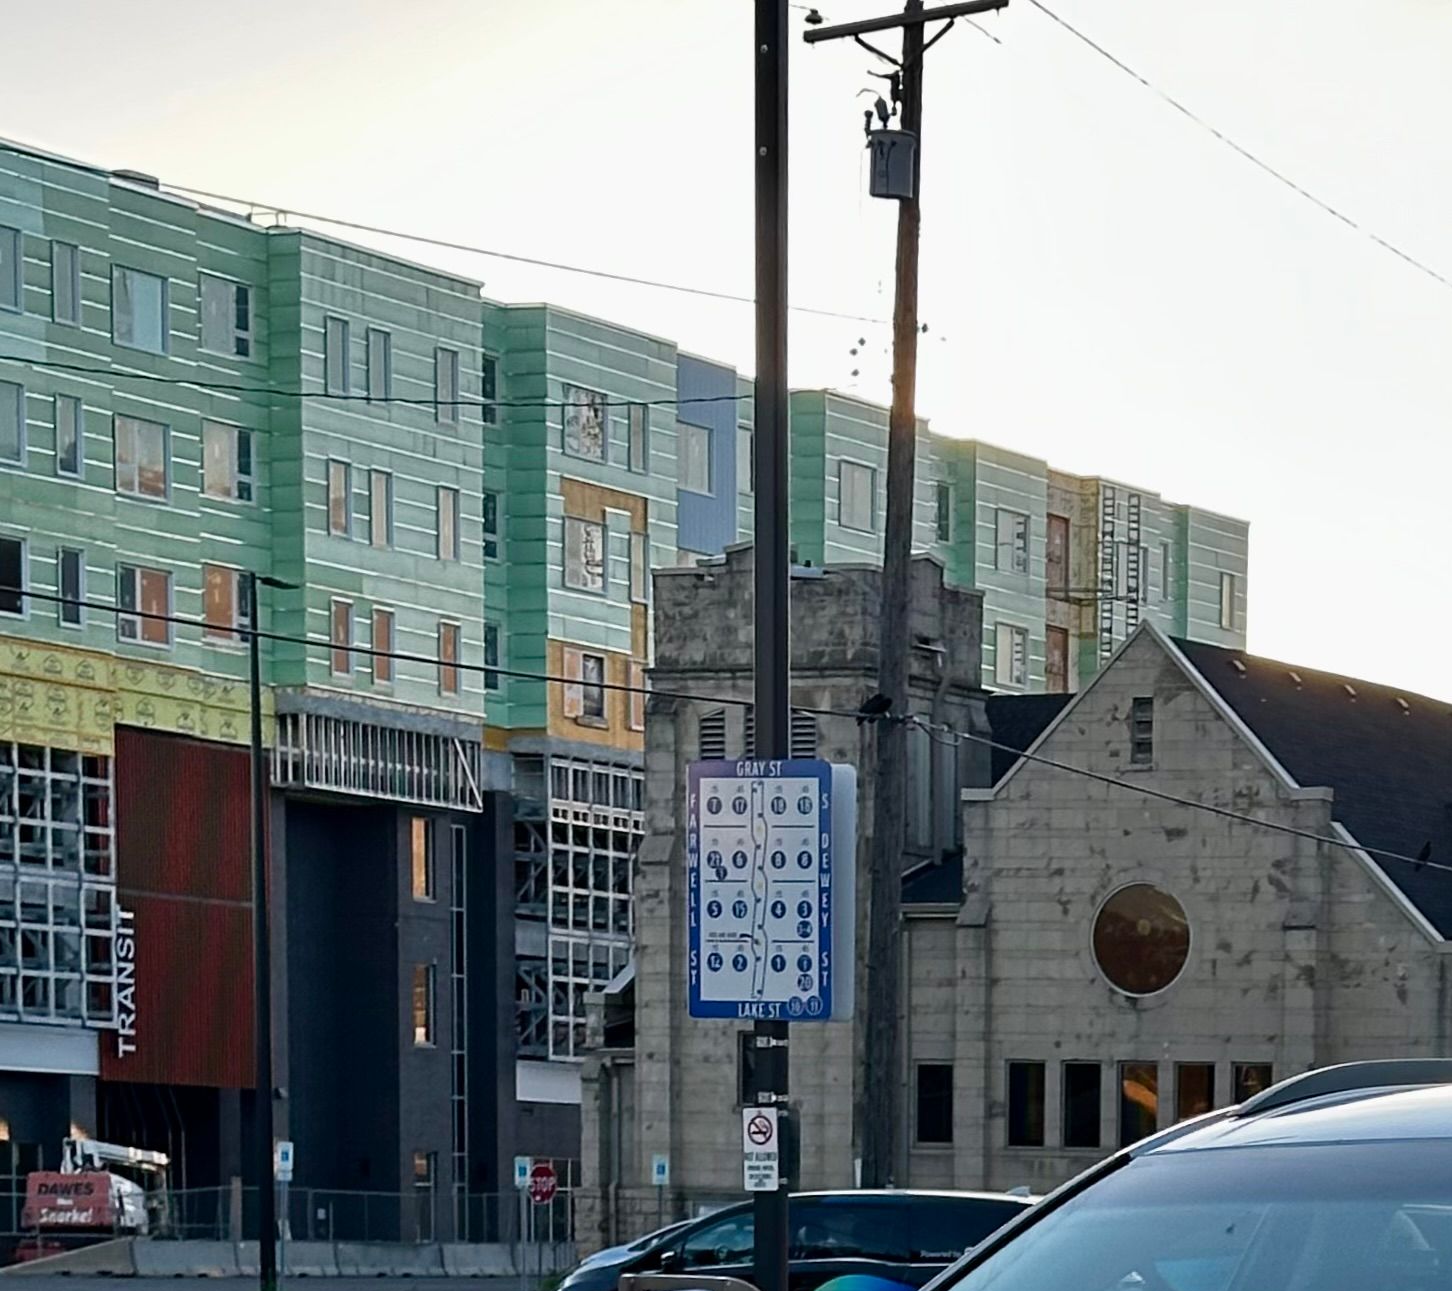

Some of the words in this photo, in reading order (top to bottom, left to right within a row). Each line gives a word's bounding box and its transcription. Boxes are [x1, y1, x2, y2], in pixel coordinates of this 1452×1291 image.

[736, 761, 766, 776] GRAY
[768, 761, 782, 776] ST
[821, 793, 829, 809] S
[688, 793, 699, 927] FARWELL
[820, 833, 831, 928] DEWEY
[821, 951, 829, 987] ST
[116, 904, 136, 1059] TRANSIT
[737, 1003, 766, 1017] LAKE
[768, 1003, 782, 1018] ST
[37, 1182, 95, 1196] DAWES
[530, 1176, 556, 1192] STOP
